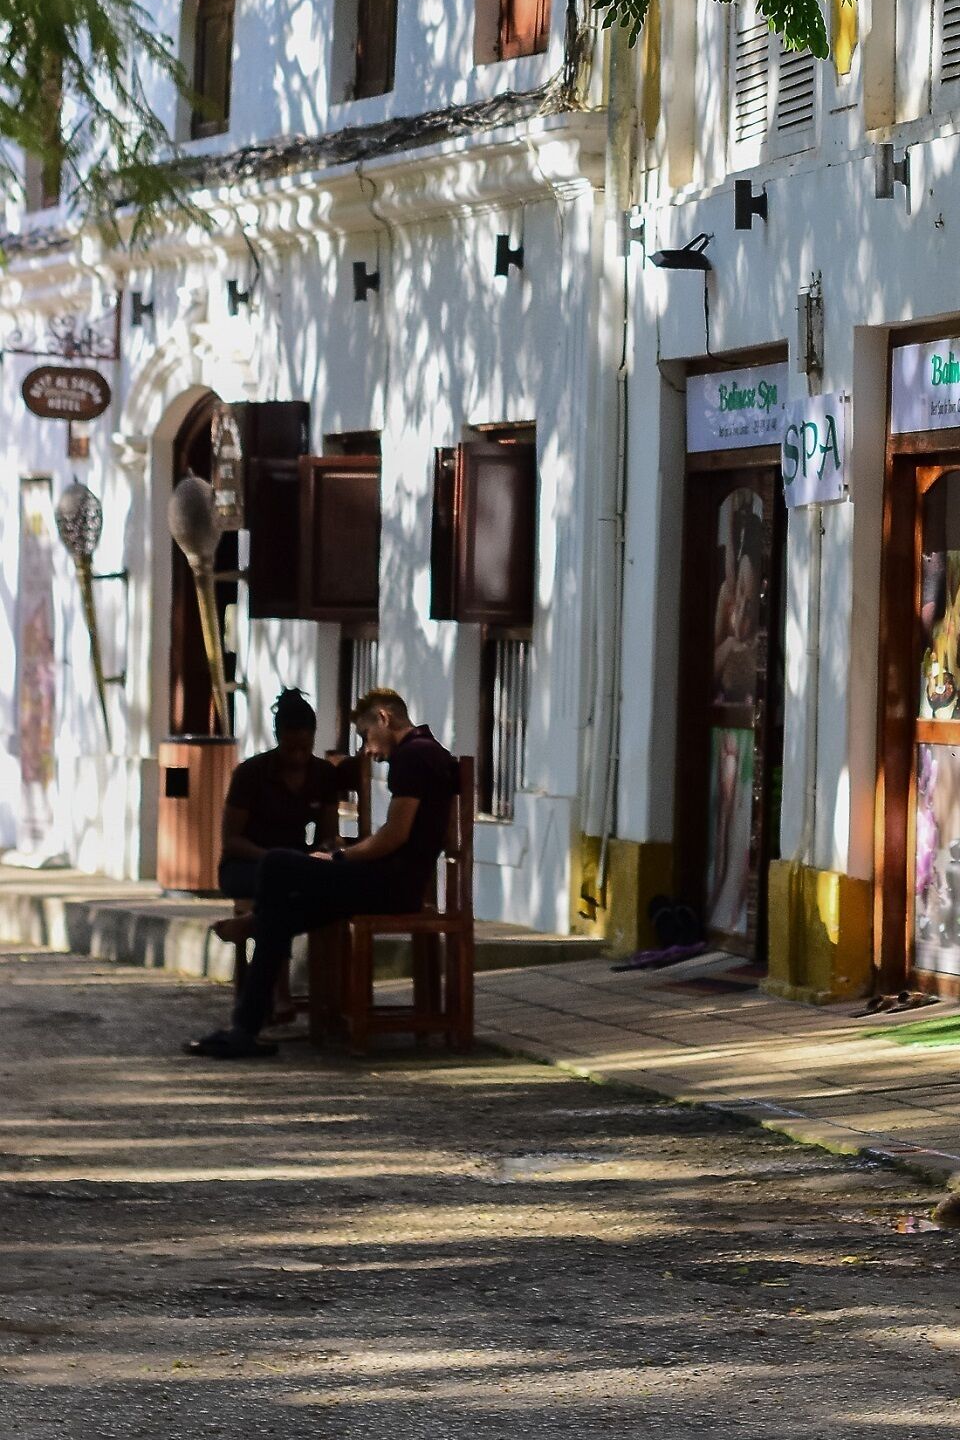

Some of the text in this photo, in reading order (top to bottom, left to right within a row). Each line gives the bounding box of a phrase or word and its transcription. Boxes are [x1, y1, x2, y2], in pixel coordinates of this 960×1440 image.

[718, 380, 778, 414] Balinese Spa
[783, 414, 842, 486] SPA
